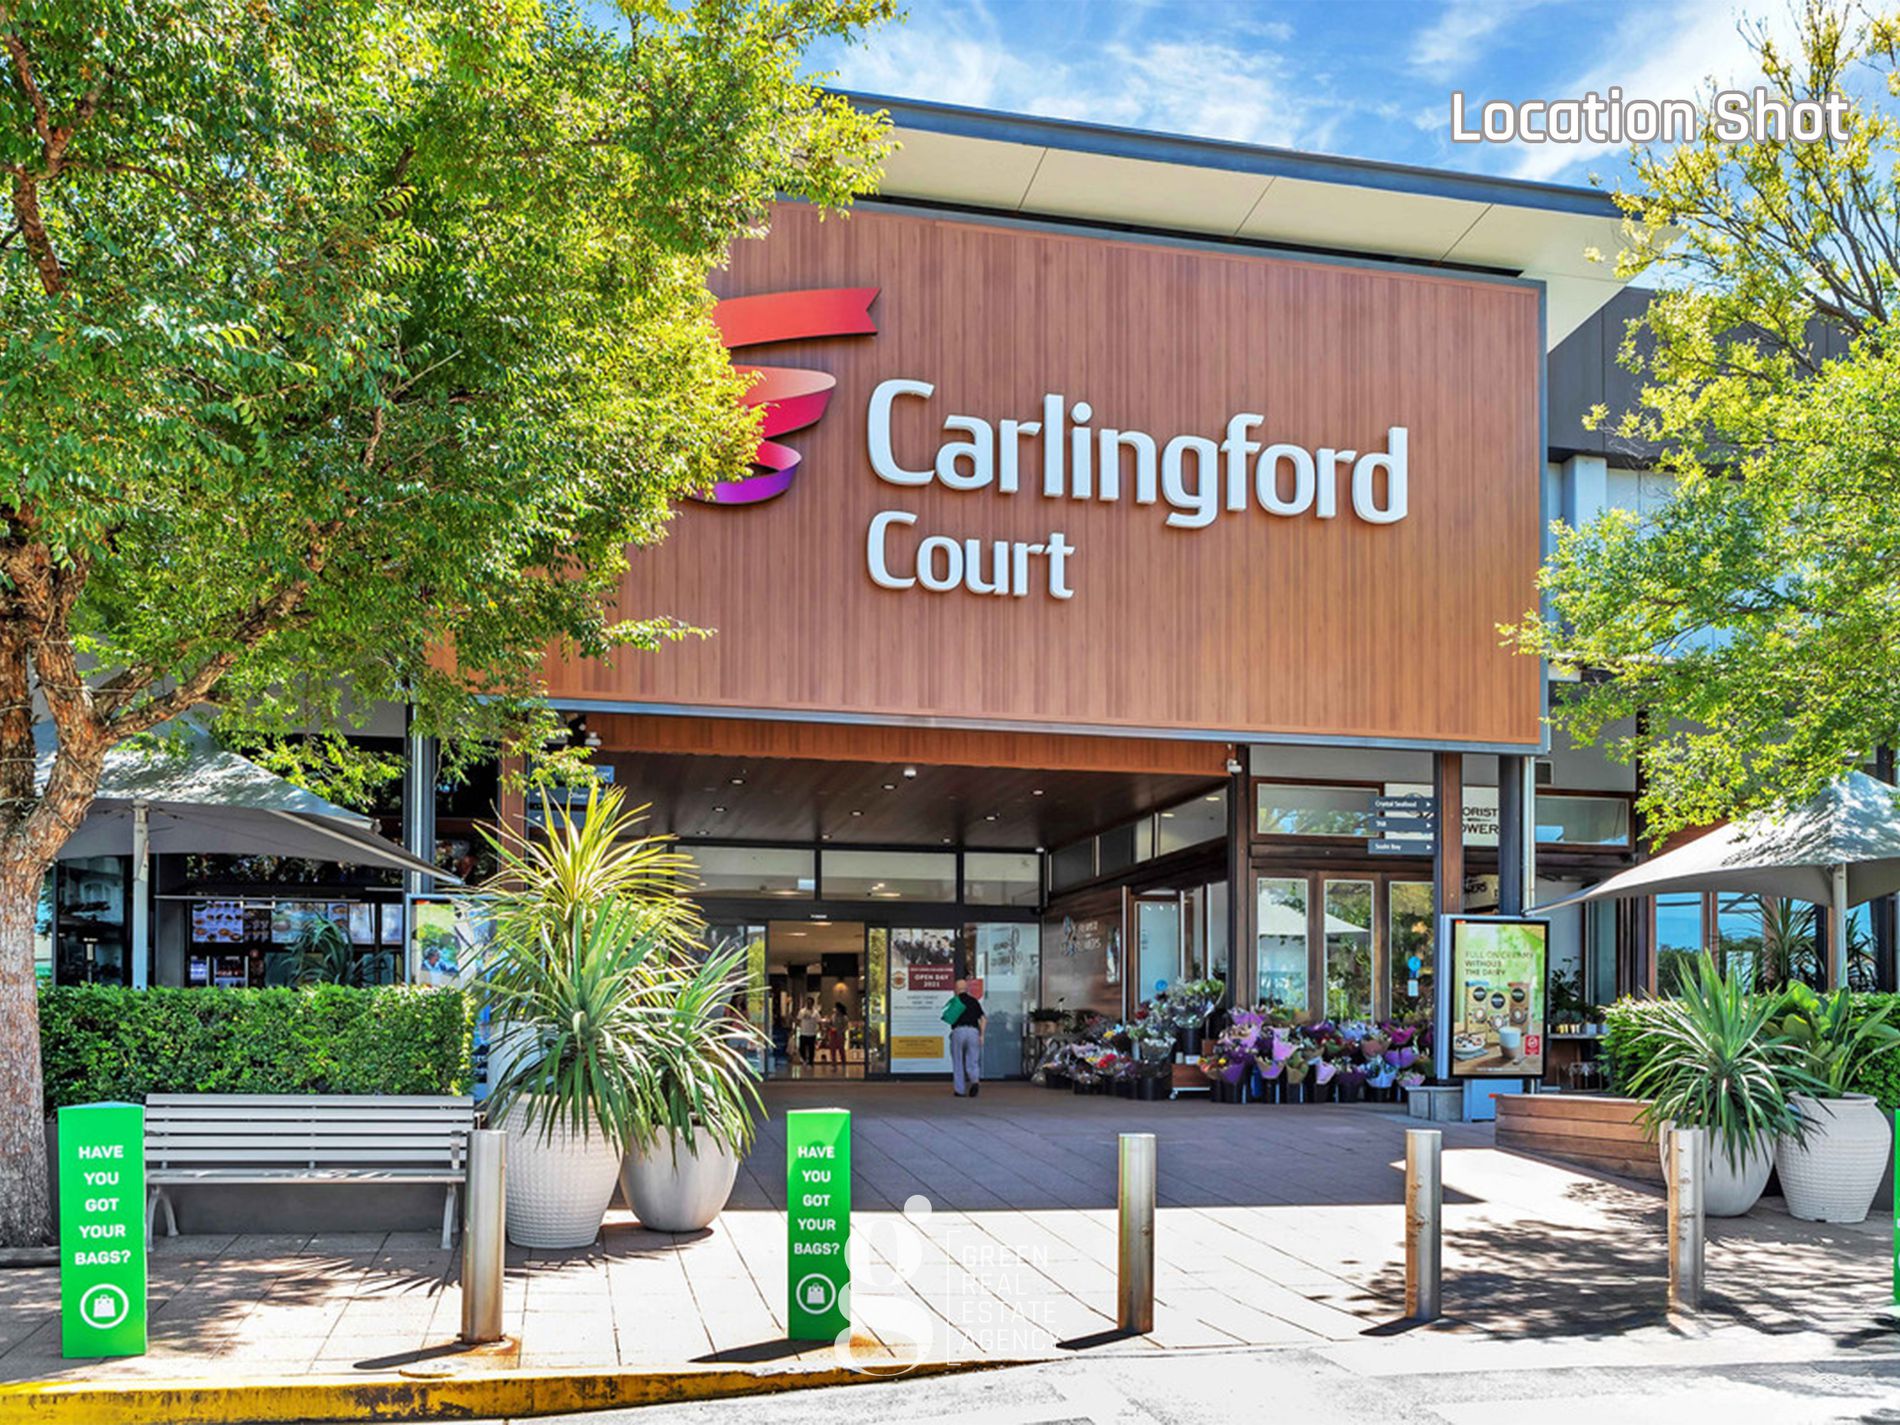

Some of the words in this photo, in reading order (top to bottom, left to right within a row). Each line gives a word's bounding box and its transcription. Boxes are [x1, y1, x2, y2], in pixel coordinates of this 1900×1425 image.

[867, 378, 1409, 529] Carlingford
[866, 510, 1075, 599] Court
[78, 1145, 124, 1159] HAVE
[797, 1145, 836, 1159] HAVE
[84, 1171, 119, 1186] YOU
[801, 1170, 831, 1183] YOU
[85, 1198, 120, 1212] GOT
[802, 1194, 831, 1207] GOT
[79, 1224, 126, 1239] YOUR
[797, 1218, 837, 1231] YOUR
[793, 1242, 841, 1256] BAGS?
[74, 1250, 131, 1266] BAGS?
